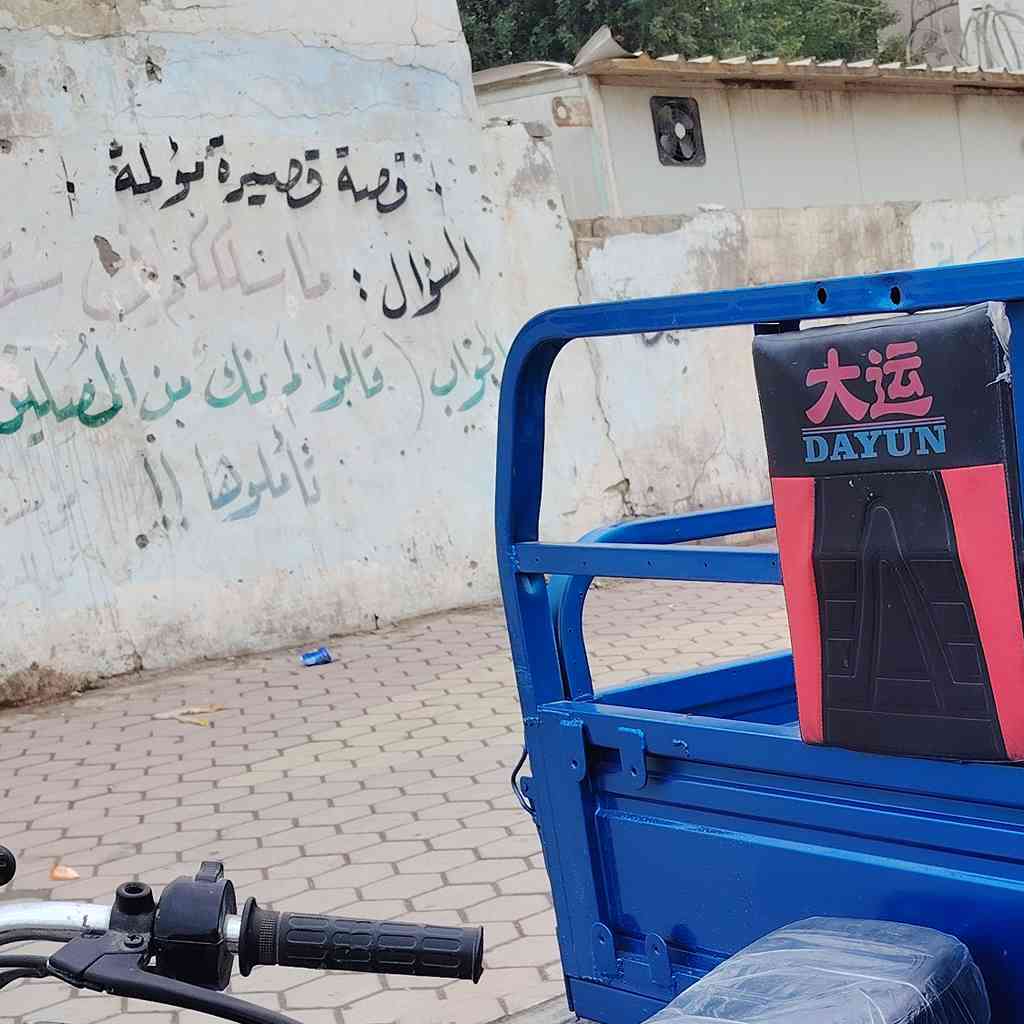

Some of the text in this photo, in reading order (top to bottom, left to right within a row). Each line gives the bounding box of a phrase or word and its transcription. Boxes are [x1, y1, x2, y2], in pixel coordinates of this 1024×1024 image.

[205, 135, 323, 209] قصيرة
[337, 146, 408, 213] قصة
[806, 340, 933, 424] 大运
[802, 425, 946, 463] DAYUN
